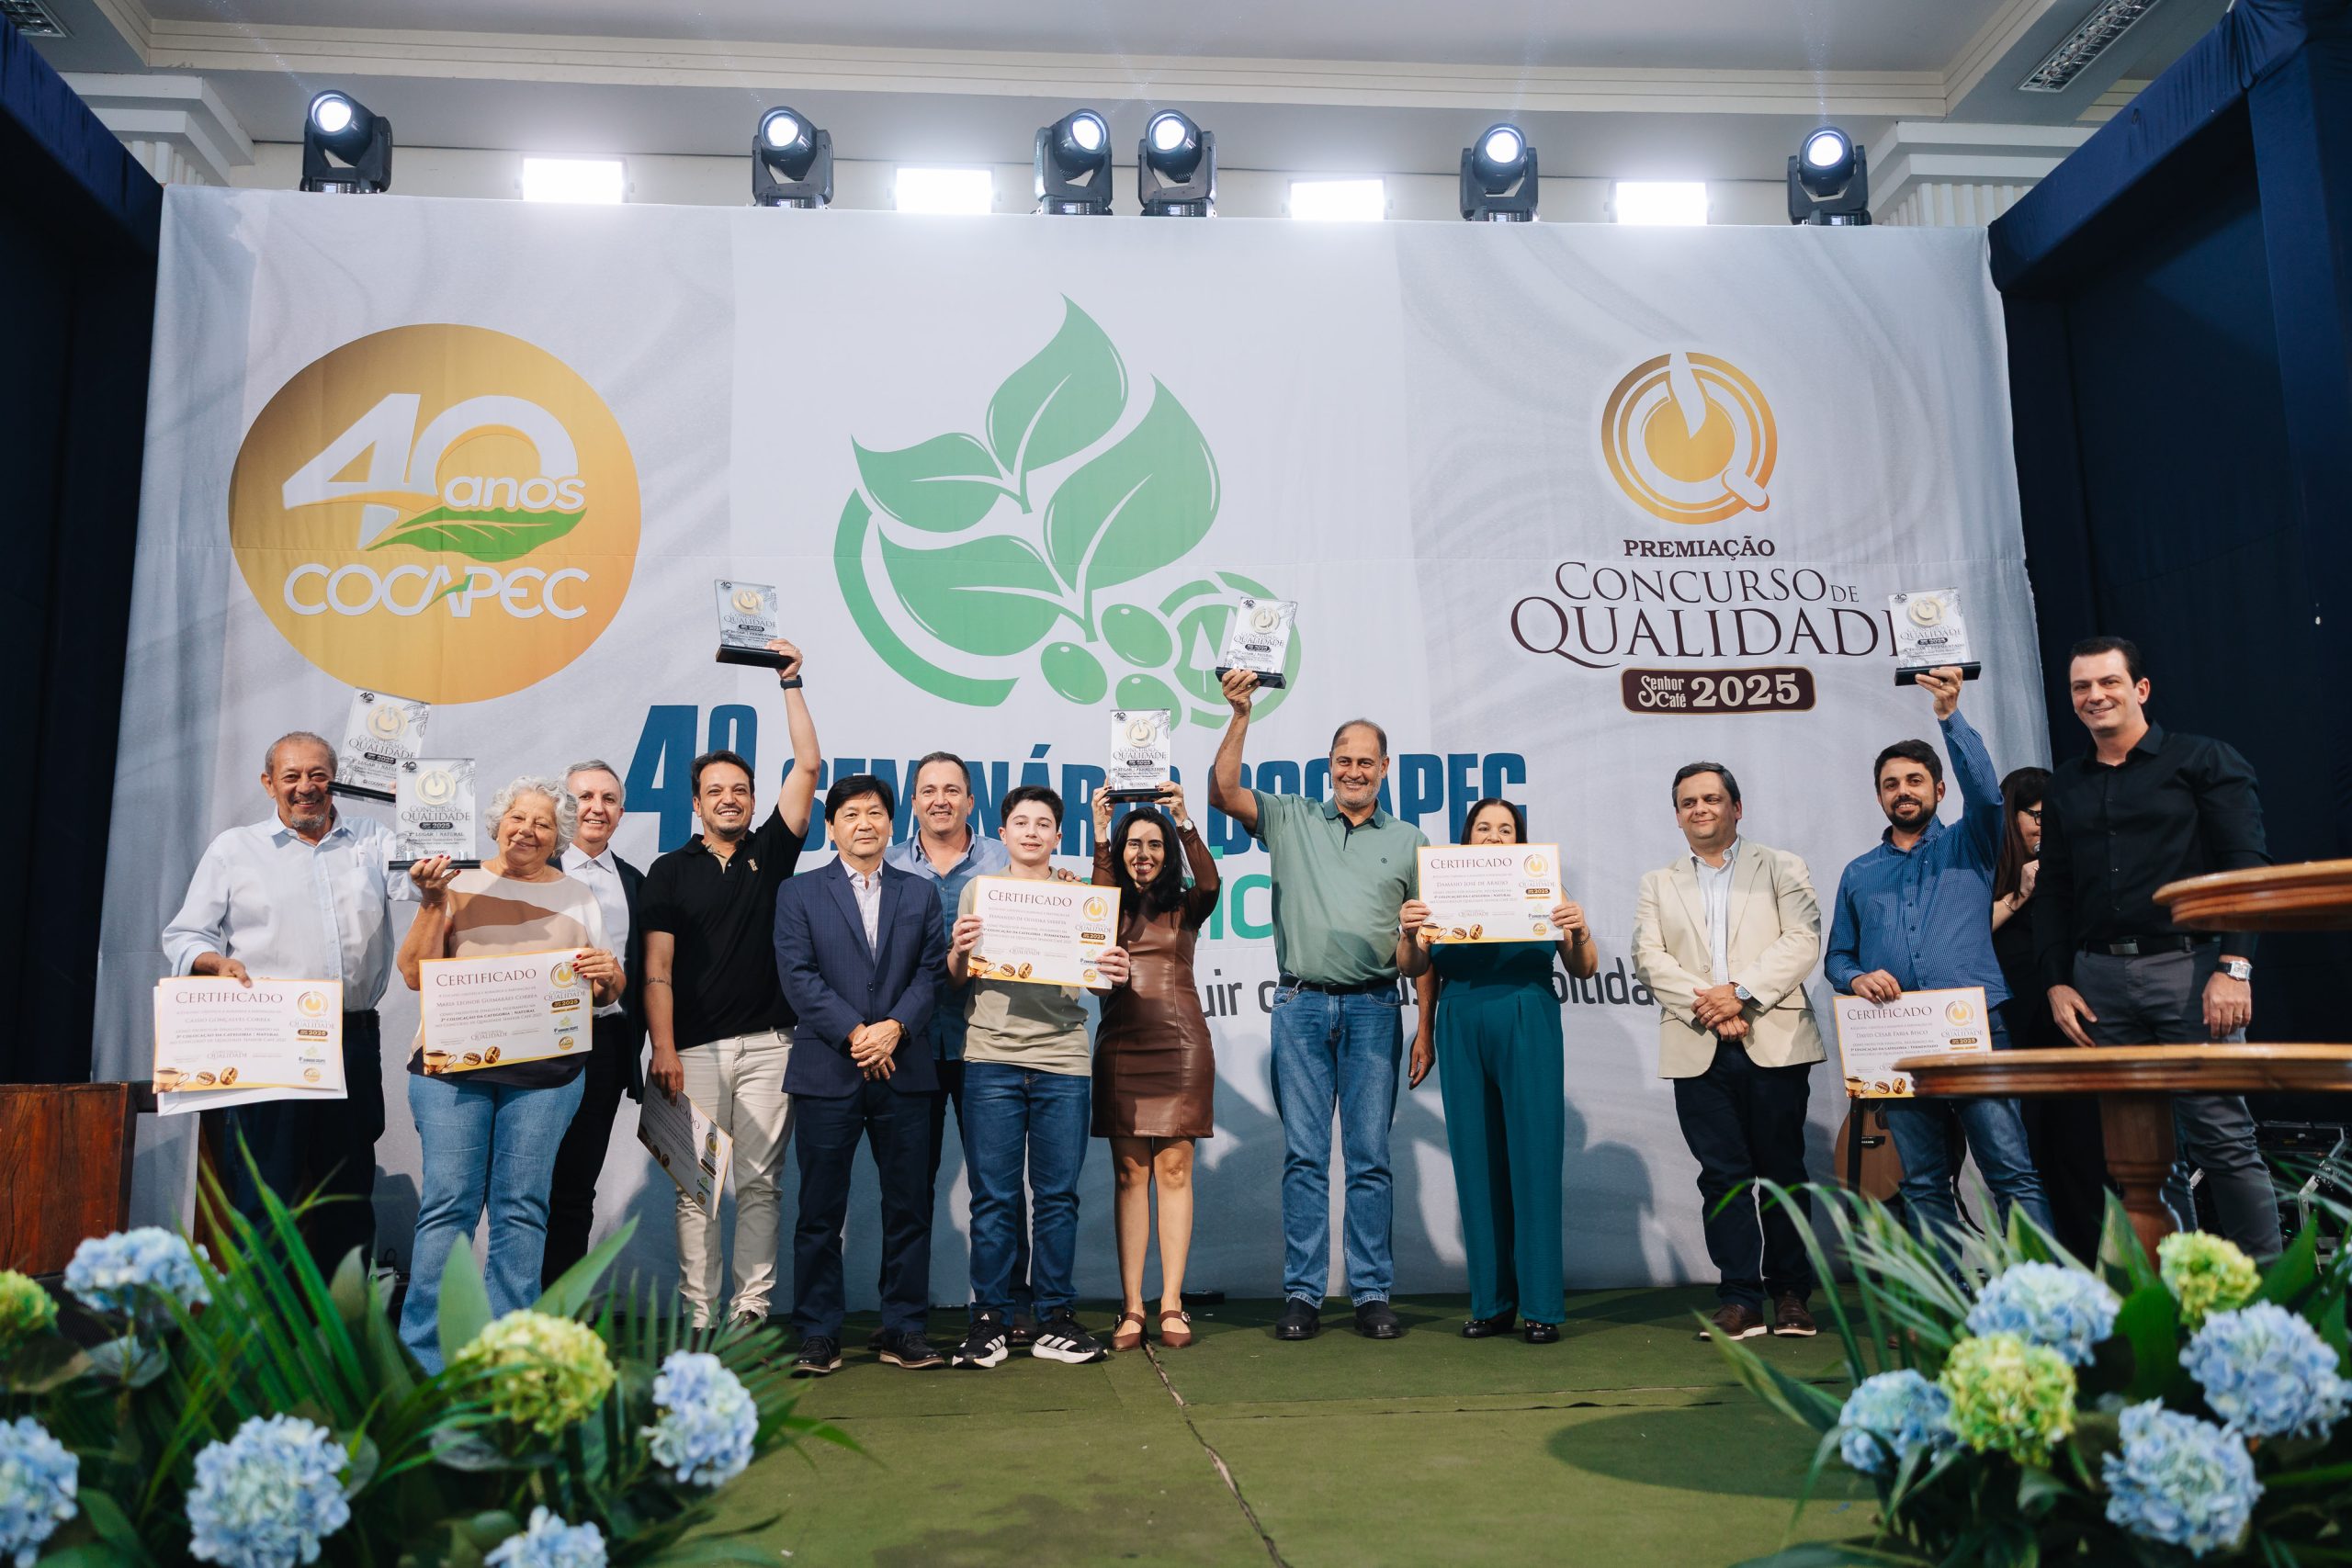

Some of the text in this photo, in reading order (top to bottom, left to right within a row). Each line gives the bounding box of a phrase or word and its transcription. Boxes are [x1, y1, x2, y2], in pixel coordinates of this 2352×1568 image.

[283, 393, 579, 550] 40
[445, 476, 585, 509] anos
[1623, 536, 1776, 561] PREMIAÇÃO
[283, 563, 590, 619] COCAPEC
[1555, 561, 1860, 604] CONCURSO DE
[1900, 628, 1962, 640] QUALIDADE
[1638, 675, 1684, 707] Senhor
[1656, 691, 1687, 708] Café
[1690, 673, 1800, 707] 2025
[348, 738, 416, 759] QUALIDADE
[1113, 751, 1167, 761] QUALIDADE
[401, 811, 470, 823] QUALIDADE
[1430, 857, 1512, 870] CERTIFICADO
[988, 889, 1072, 908] CERTIFICADO
[435, 968, 537, 987] CERTIFICADO
[175, 991, 283, 1005] CERTIFICADO
[544, 990, 585, 1001] QUALIDADE
[1847, 1006, 1932, 1021] CERTIFICADO
